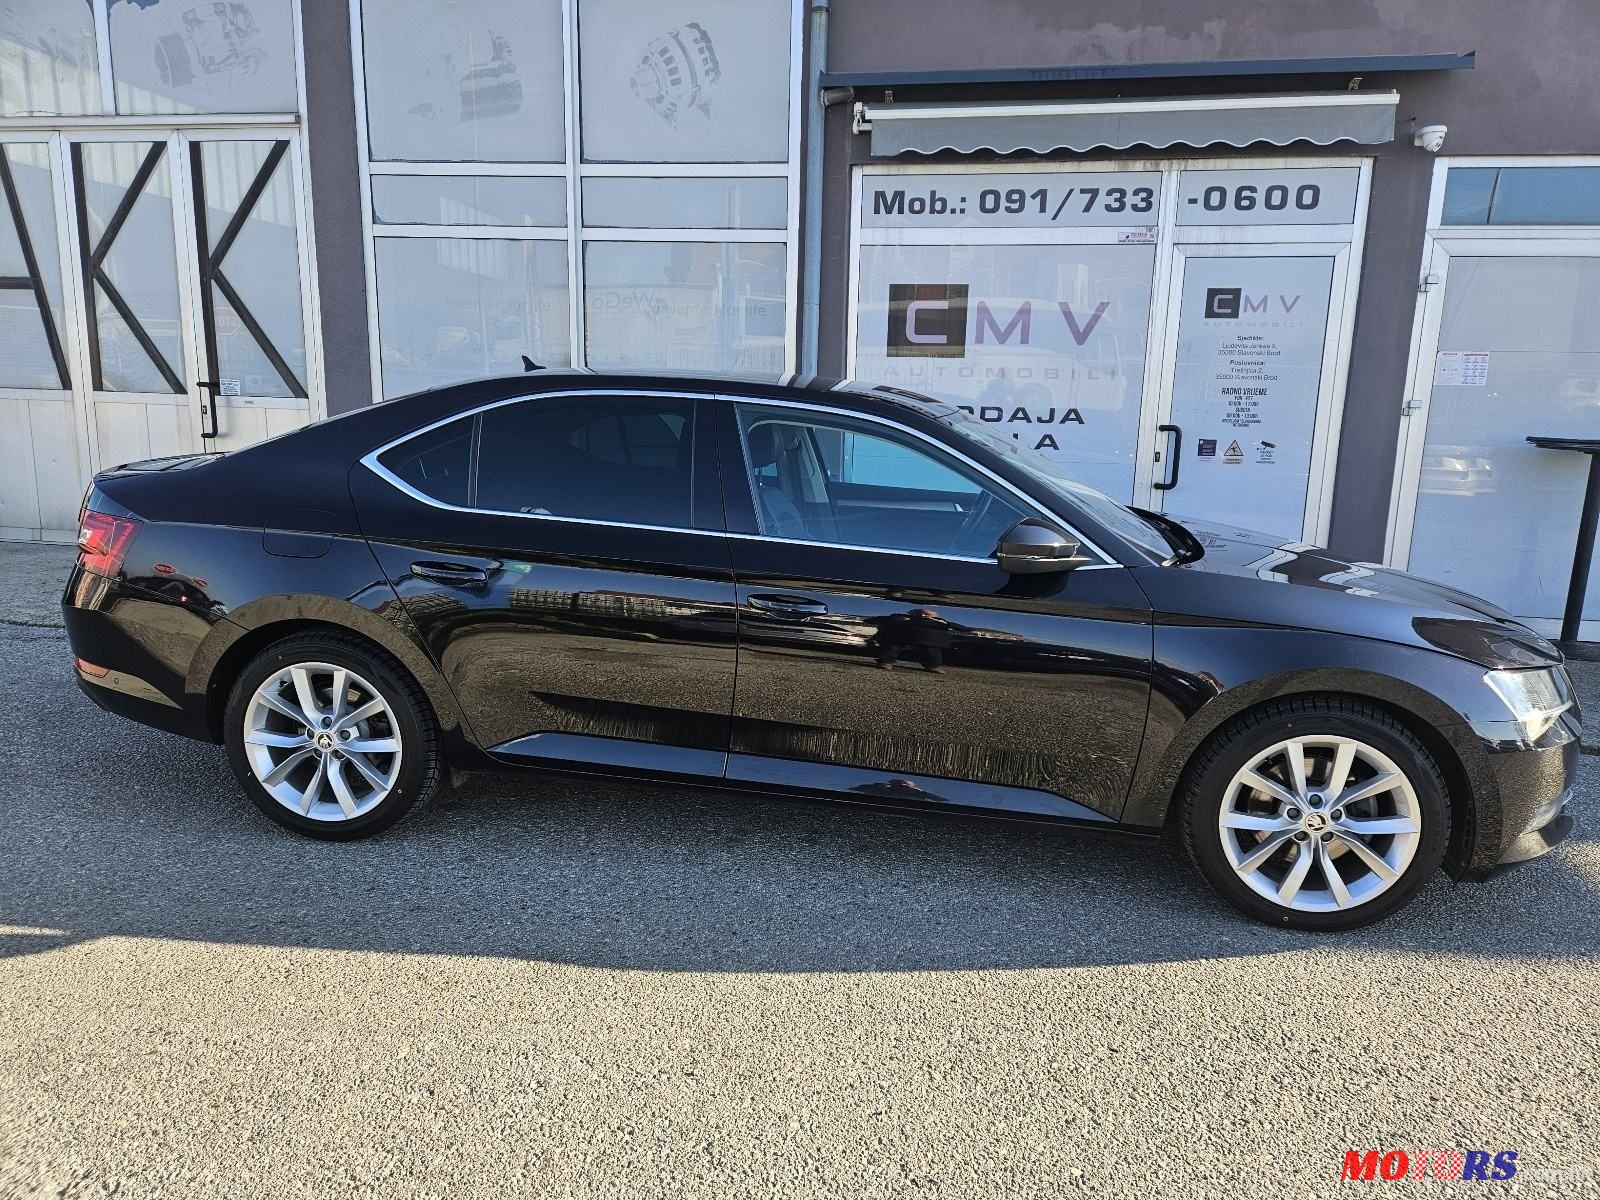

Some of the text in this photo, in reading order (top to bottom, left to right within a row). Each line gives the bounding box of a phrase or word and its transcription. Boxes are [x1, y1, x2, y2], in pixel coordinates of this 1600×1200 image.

[873, 184, 1321, 221] Mob.: 091/733 -0600
[1213, 294, 1301, 313] CMV
[905, 300, 1111, 346] CMV
[883, 365, 1119, 381] AUTOMOBILI
[1221, 387, 1242, 395] RADNO
